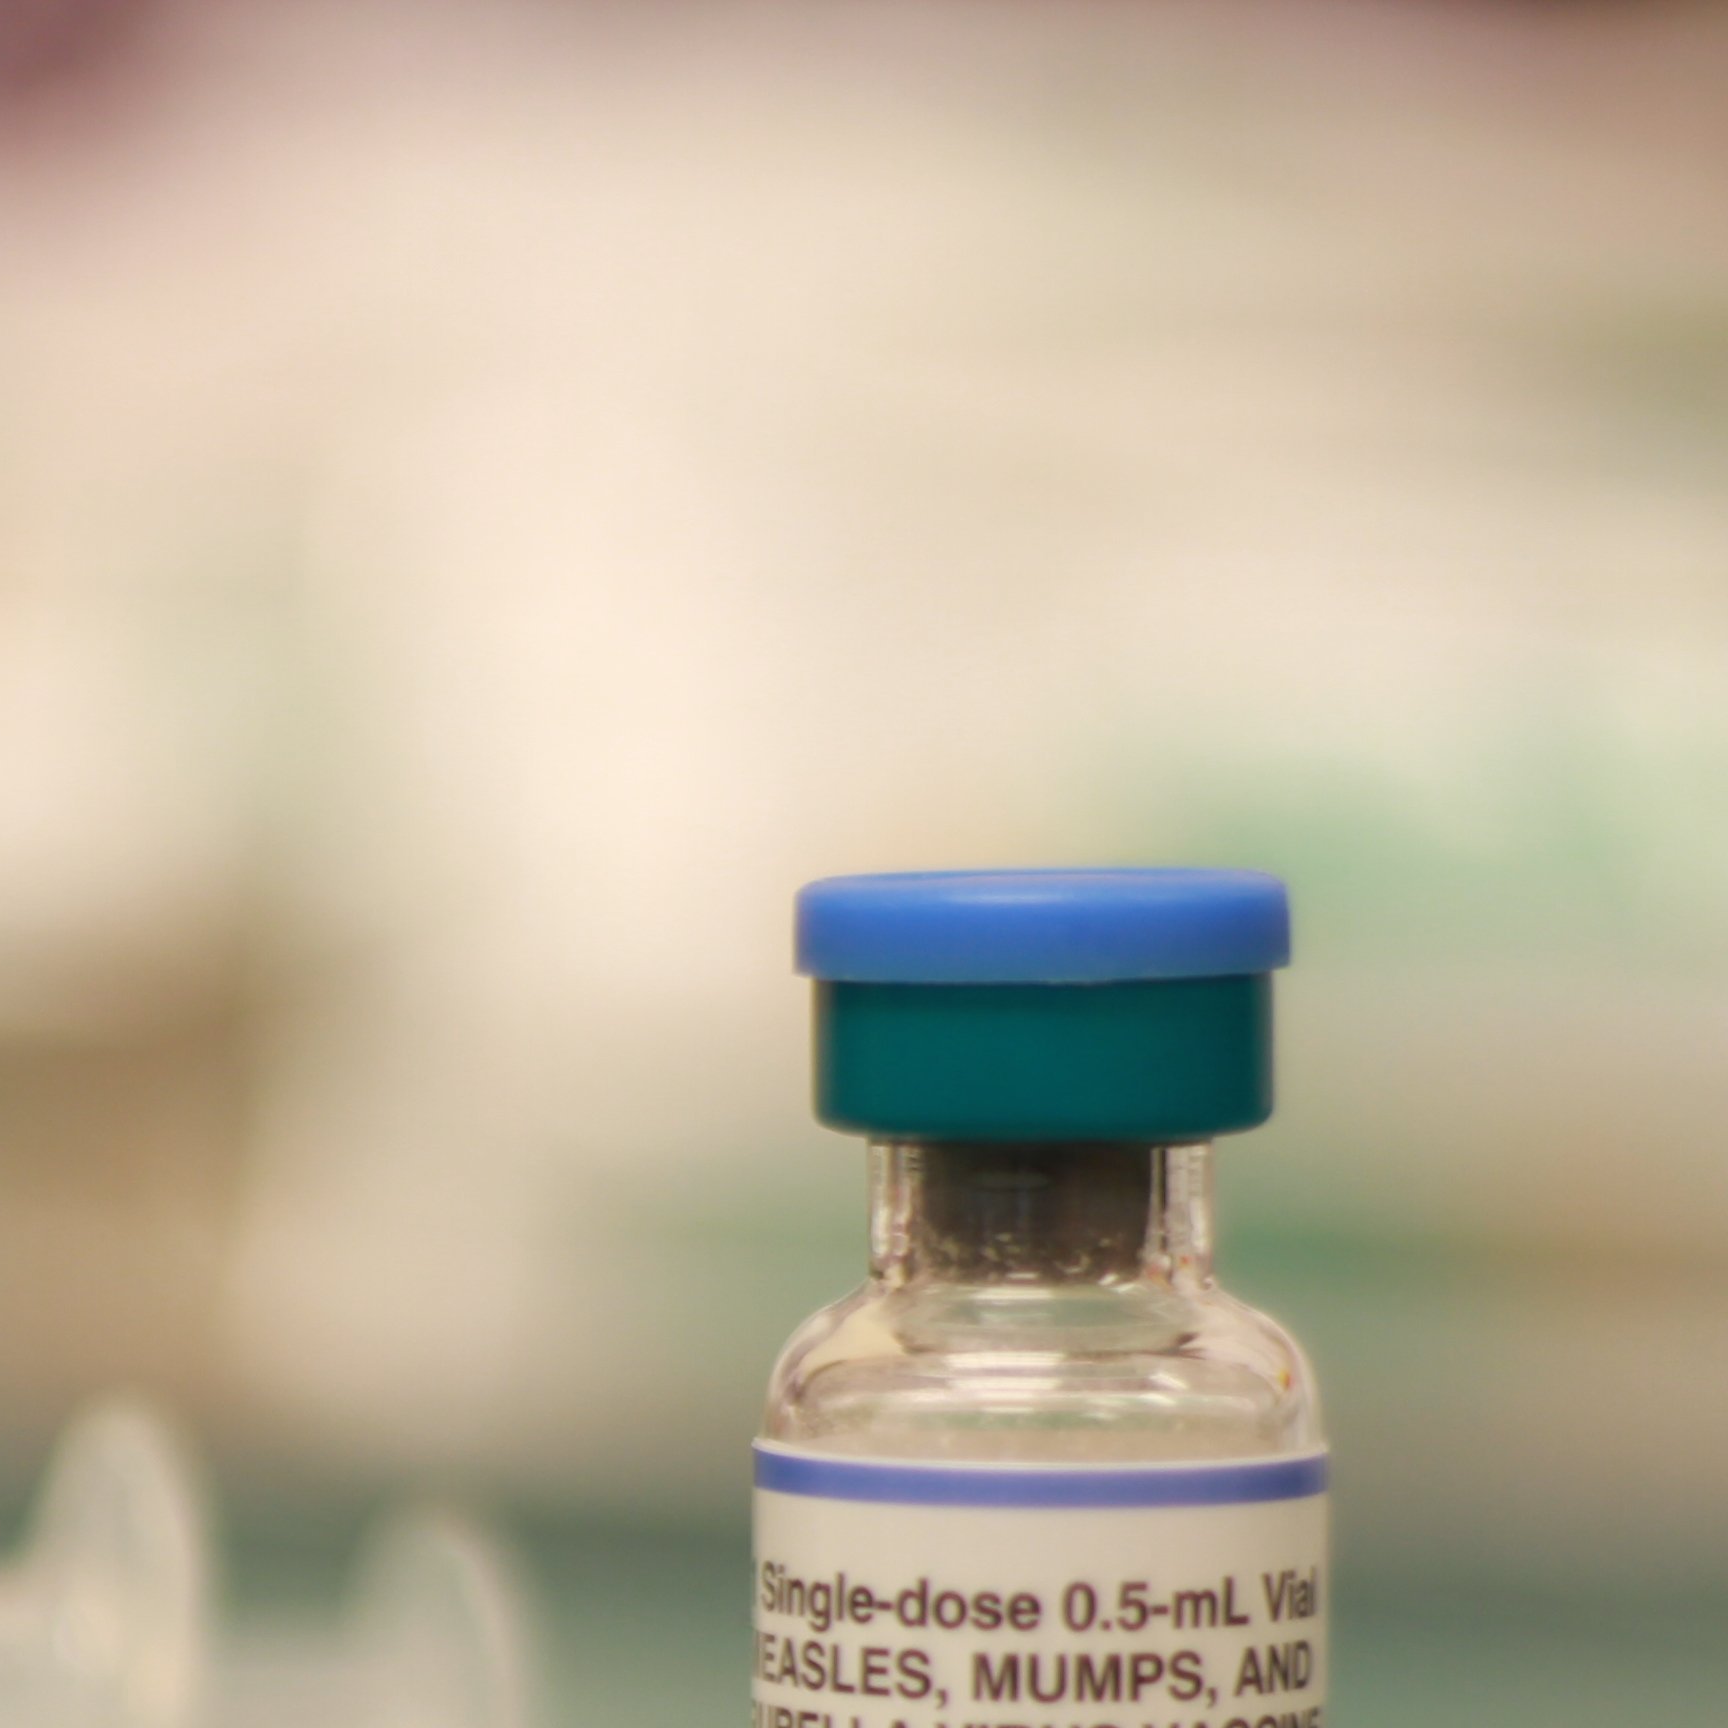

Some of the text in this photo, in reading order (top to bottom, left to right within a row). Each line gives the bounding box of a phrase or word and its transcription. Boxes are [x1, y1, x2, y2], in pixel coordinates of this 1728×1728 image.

[760, 1560, 1319, 1633] Single-dose 0.5-mL Vial
[971, 1650, 1219, 1709] MUMPS,
[1232, 1640, 1313, 1697] AND
